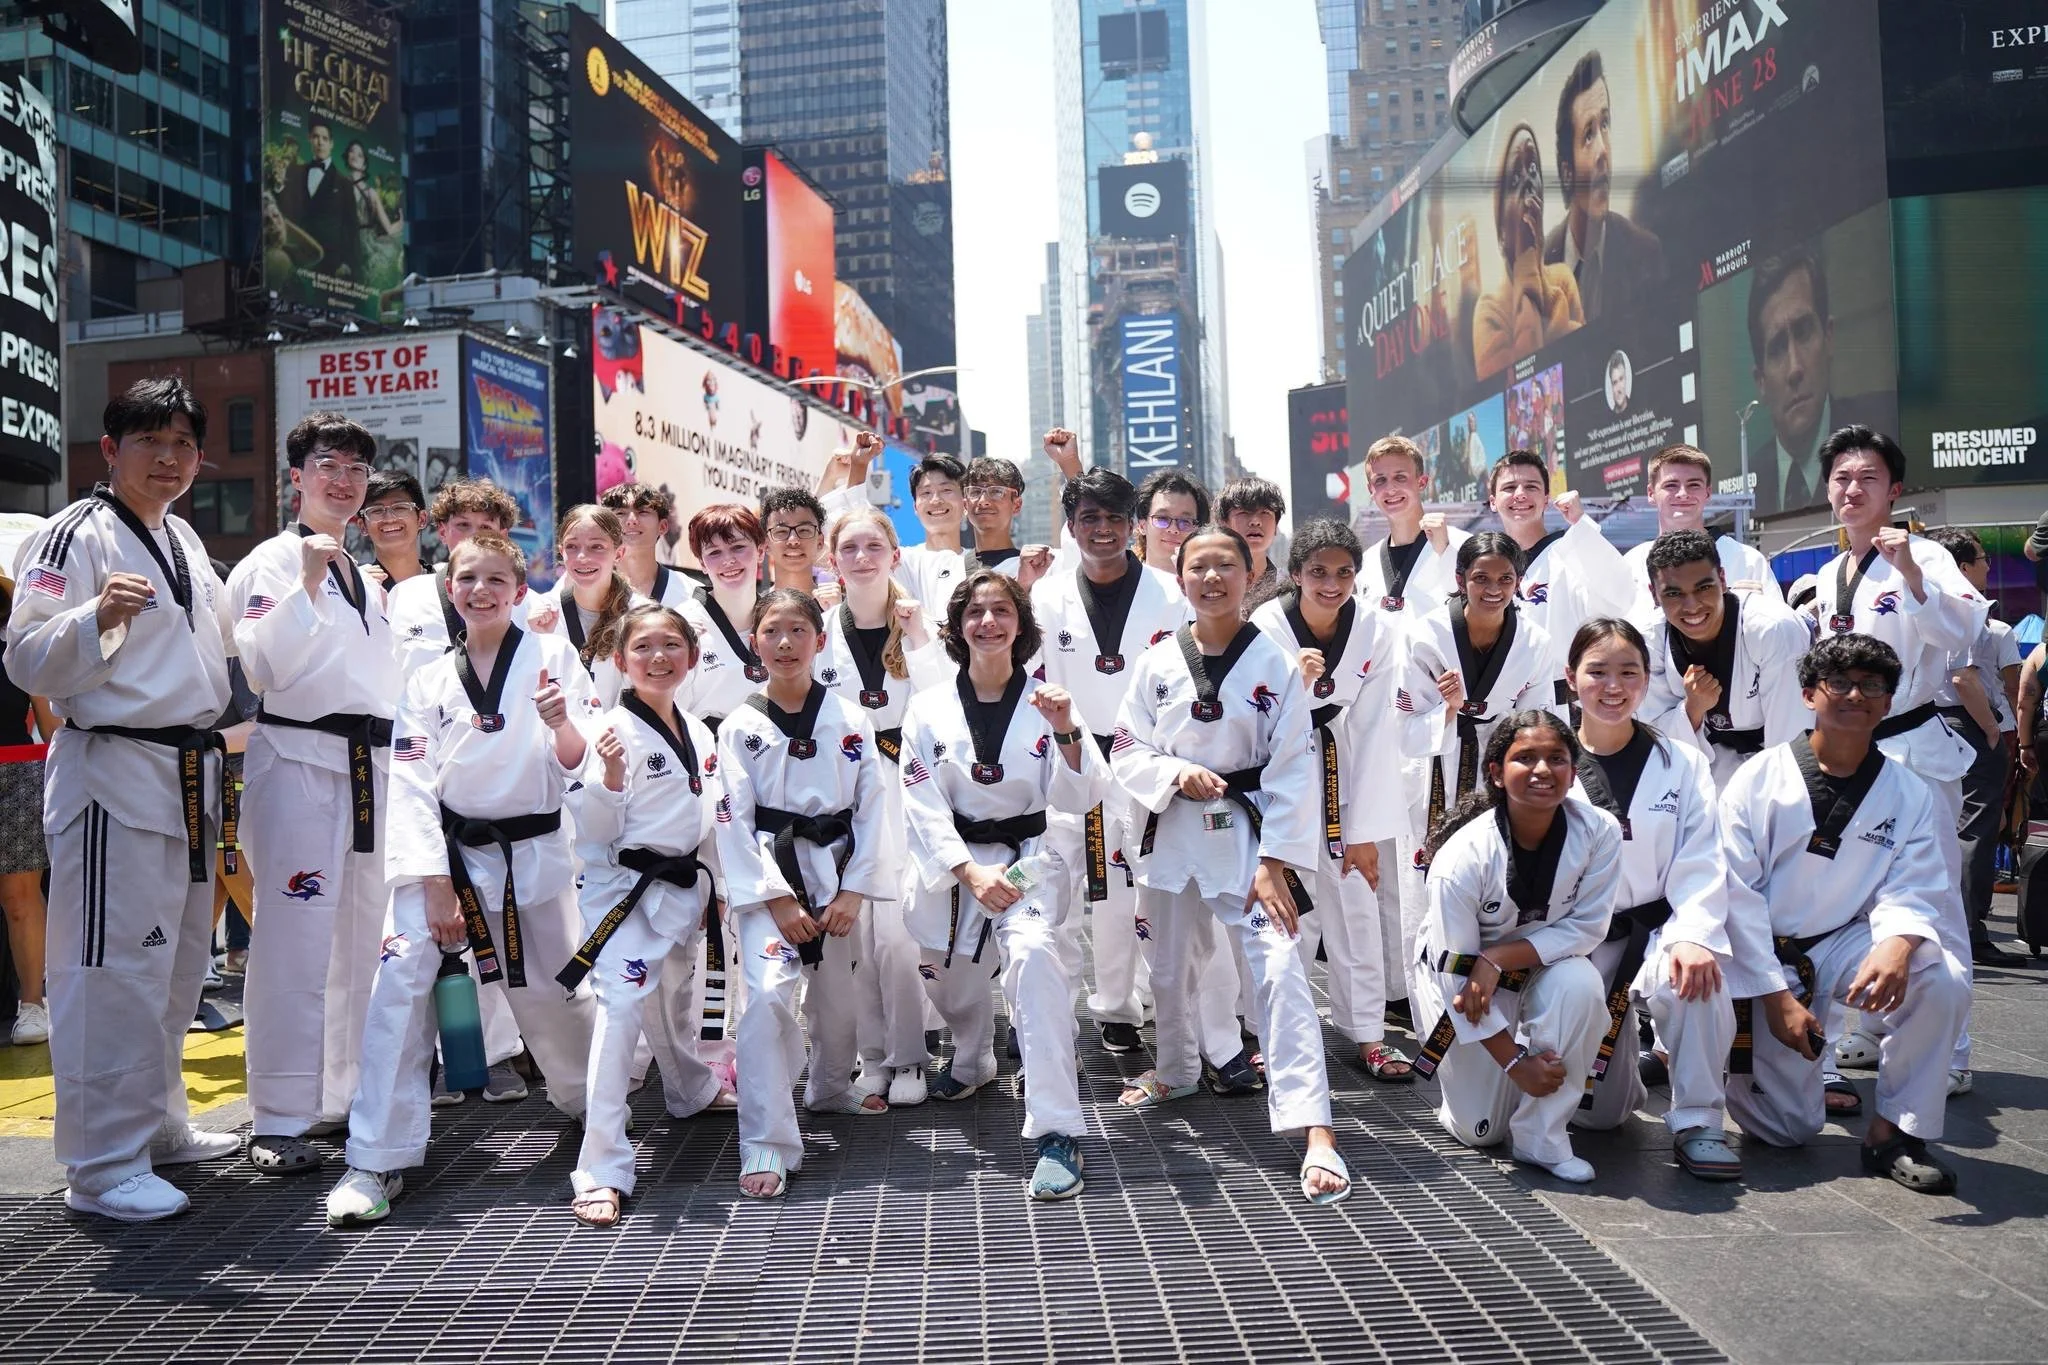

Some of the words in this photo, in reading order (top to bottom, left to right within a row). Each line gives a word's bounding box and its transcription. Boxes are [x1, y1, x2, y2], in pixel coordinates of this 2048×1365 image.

[1676, 0, 1789, 103] IMAX
[294, 71, 381, 124] GATSBY
[324, 52, 390, 104] GREAT
[1687, 69, 1744, 145] JUNE
[1752, 47, 1777, 91] 28
[743, 189, 761, 201] LG
[625, 180, 710, 301] WIZ
[1715, 239, 1751, 266] MARRIOTT
[1716, 254, 1748, 279] MARQUIS
[1361, 271, 1407, 348] QUIET
[1411, 222, 1468, 303] PLACE
[674, 293, 762, 365] 1540
[1375, 319, 1406, 381] DAY
[1409, 290, 1449, 354] ONE
[307, 376, 357, 399] THE
[363, 369, 439, 395] YEAR!
[320, 349, 387, 375] BEST
[393, 345, 427, 368] OF
[1125, 319, 1178, 468] KEHLANI
[635, 411, 656, 440] 8.3
[661, 420, 710, 459] MILLION
[714, 438, 773, 478] IMAGINARY
[776, 462, 811, 491] FRIENDS
[1932, 427, 2037, 450] PRESUMED
[1933, 446, 2028, 468] INNOCENT
[731, 475, 750, 498] JUST
[185, 749, 197, 777] TEAM
[880, 738, 900, 756] TEAM
[187, 791, 199, 850] TAEKWONDO
[463, 887, 478, 912] SCOTT
[473, 914, 487, 940] BOZZA
[506, 905, 519, 960] TAEKWONDO
[142, 937, 168, 948] adidas
[1823, 1072, 1842, 1081] NIKE
